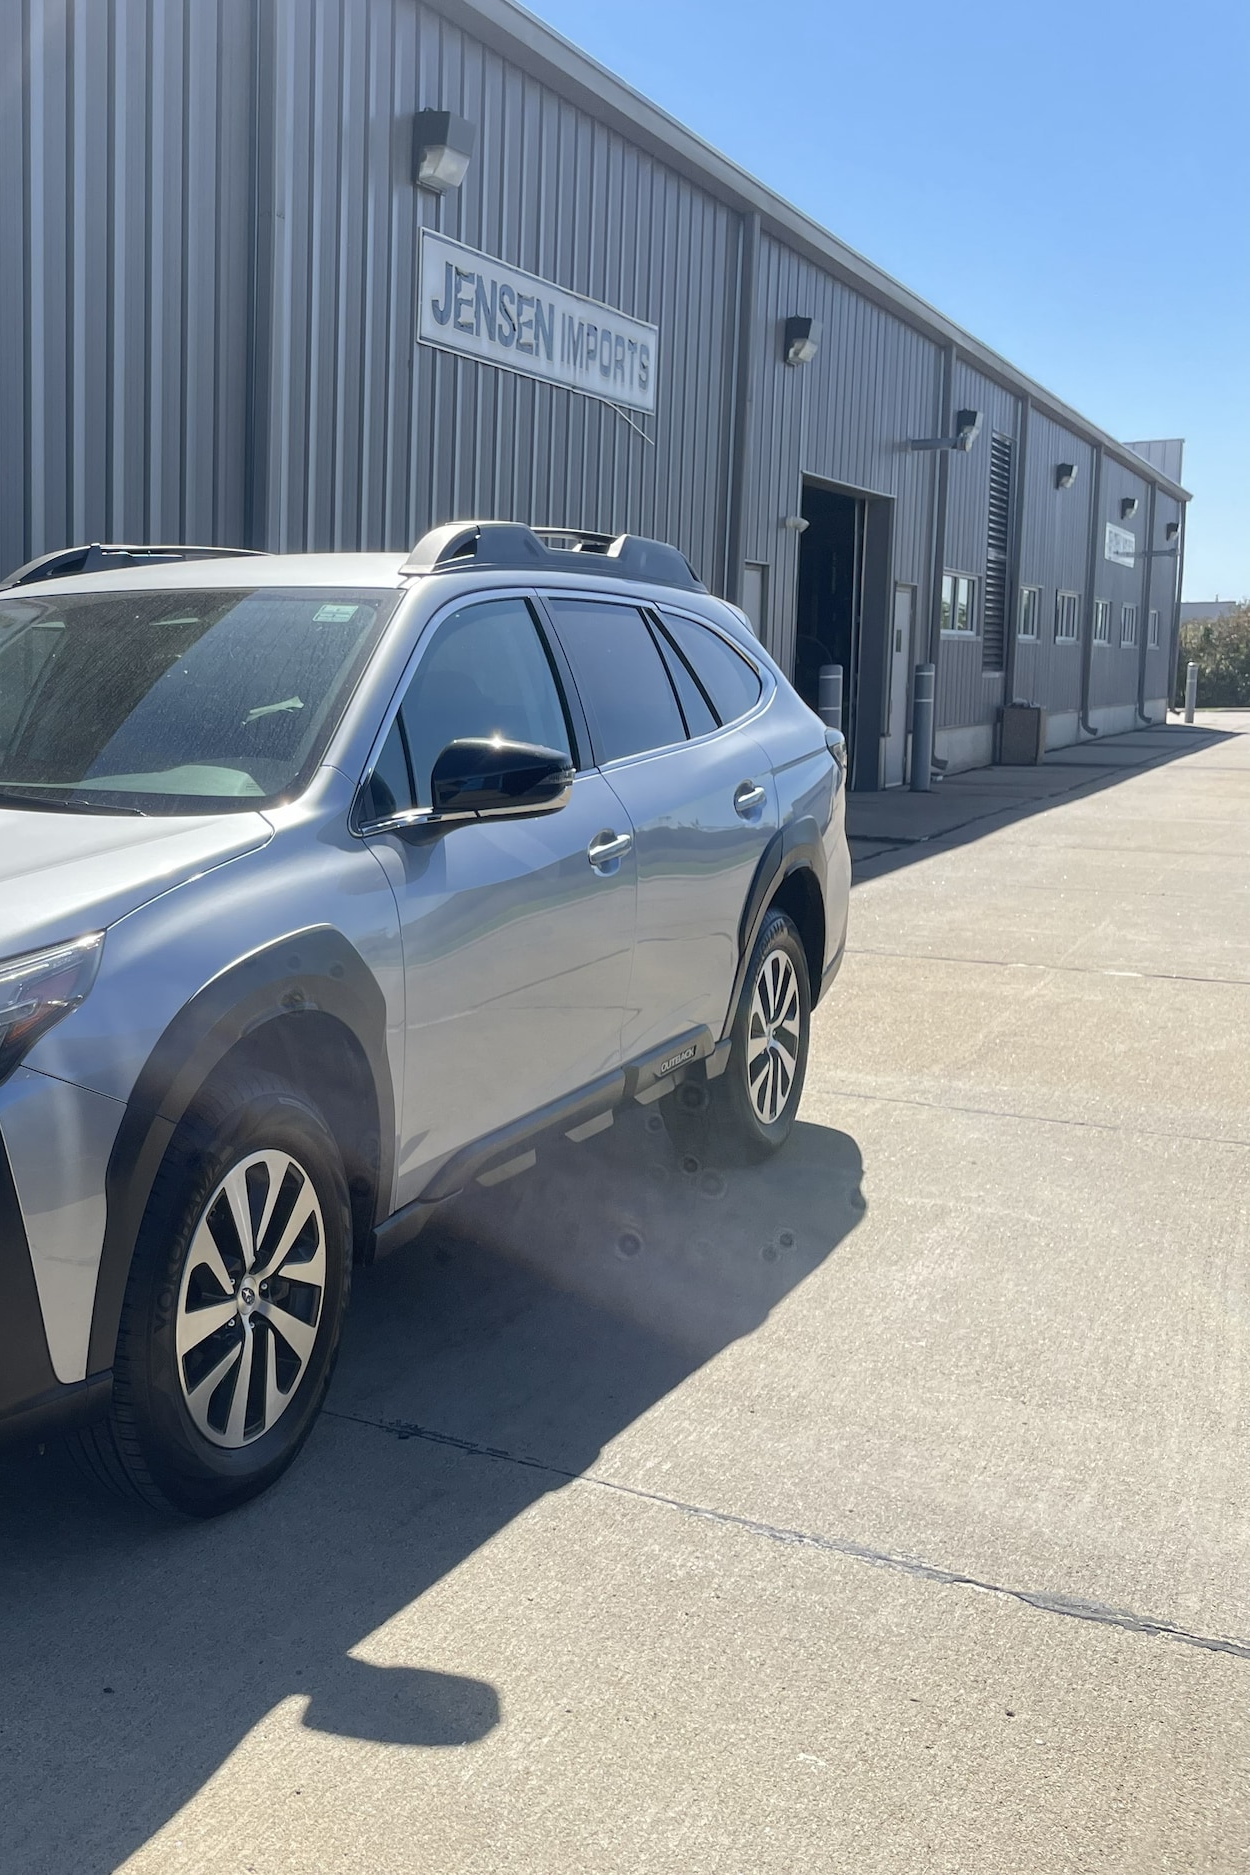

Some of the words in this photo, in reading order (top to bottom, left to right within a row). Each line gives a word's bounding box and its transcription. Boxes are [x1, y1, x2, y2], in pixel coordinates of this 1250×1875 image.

[431, 260, 555, 361] JENSEN
[561, 312, 650, 391] IMPORTS
[660, 1045, 696, 1073] OUTBACK
